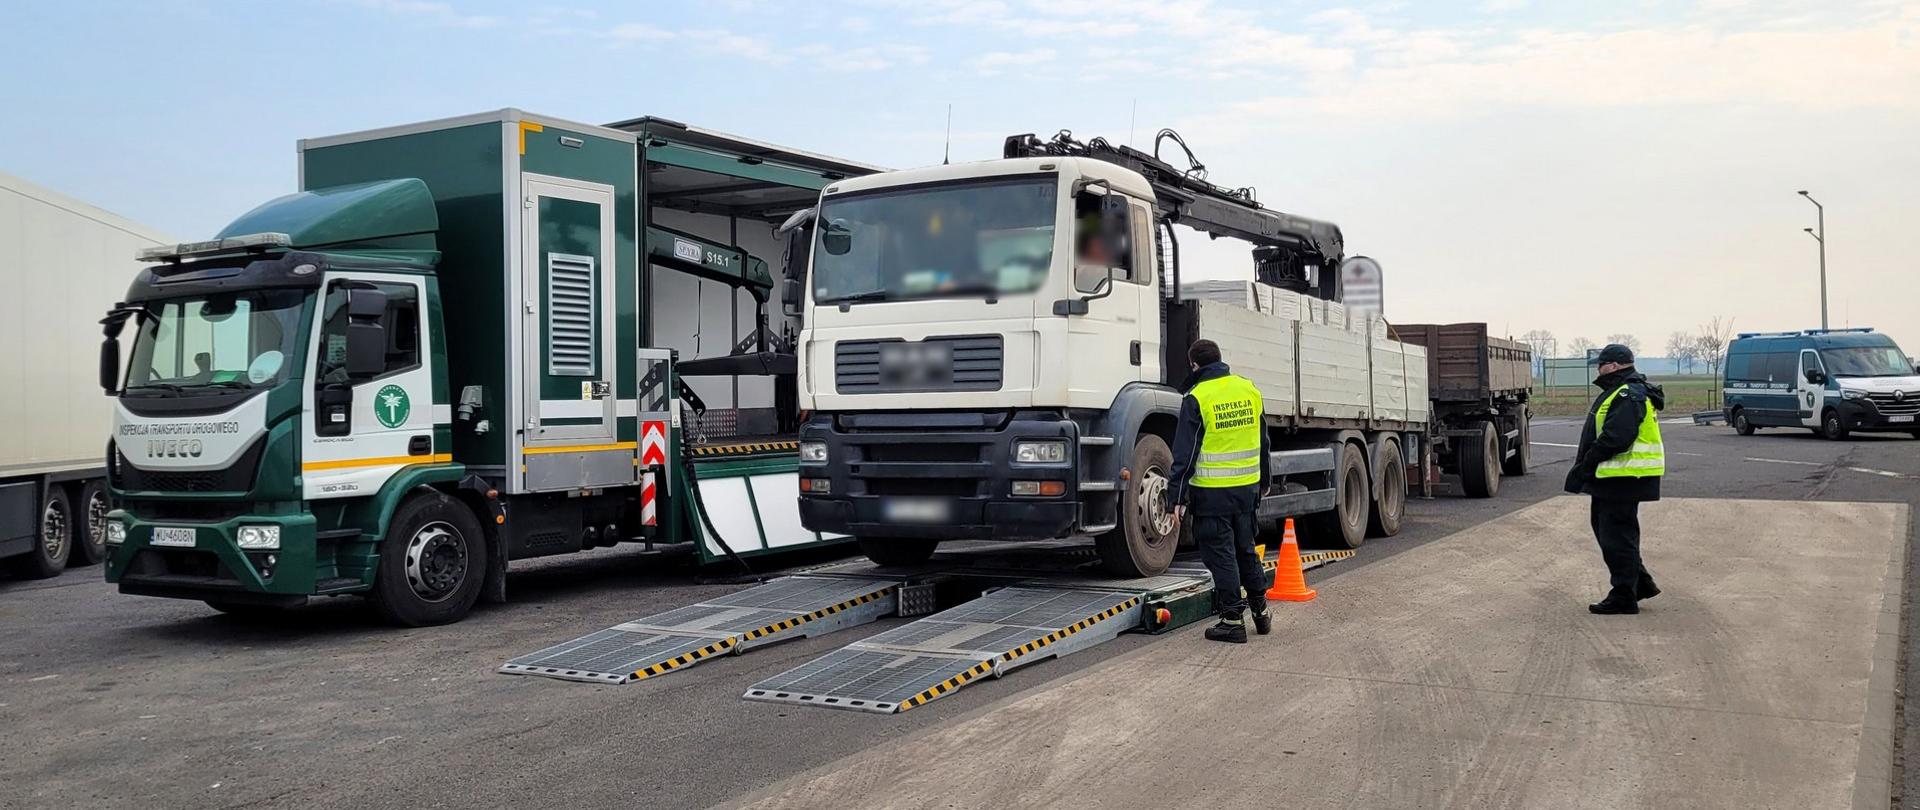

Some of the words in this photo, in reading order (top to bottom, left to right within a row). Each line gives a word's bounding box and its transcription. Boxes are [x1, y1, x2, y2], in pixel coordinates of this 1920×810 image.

[706, 251, 729, 267] S15.1
[1213, 400, 1252, 412] INSPEKCJA
[1215, 408, 1253, 420] TRANSPORTU
[119, 424, 149, 436] INSPEKCJA
[149, 423, 191, 435] TRANSPORTU
[191, 421, 239, 434] DROGOWEGO
[1215, 416, 1254, 429] DROGOWEGO
[146, 439, 203, 458] IVECO
